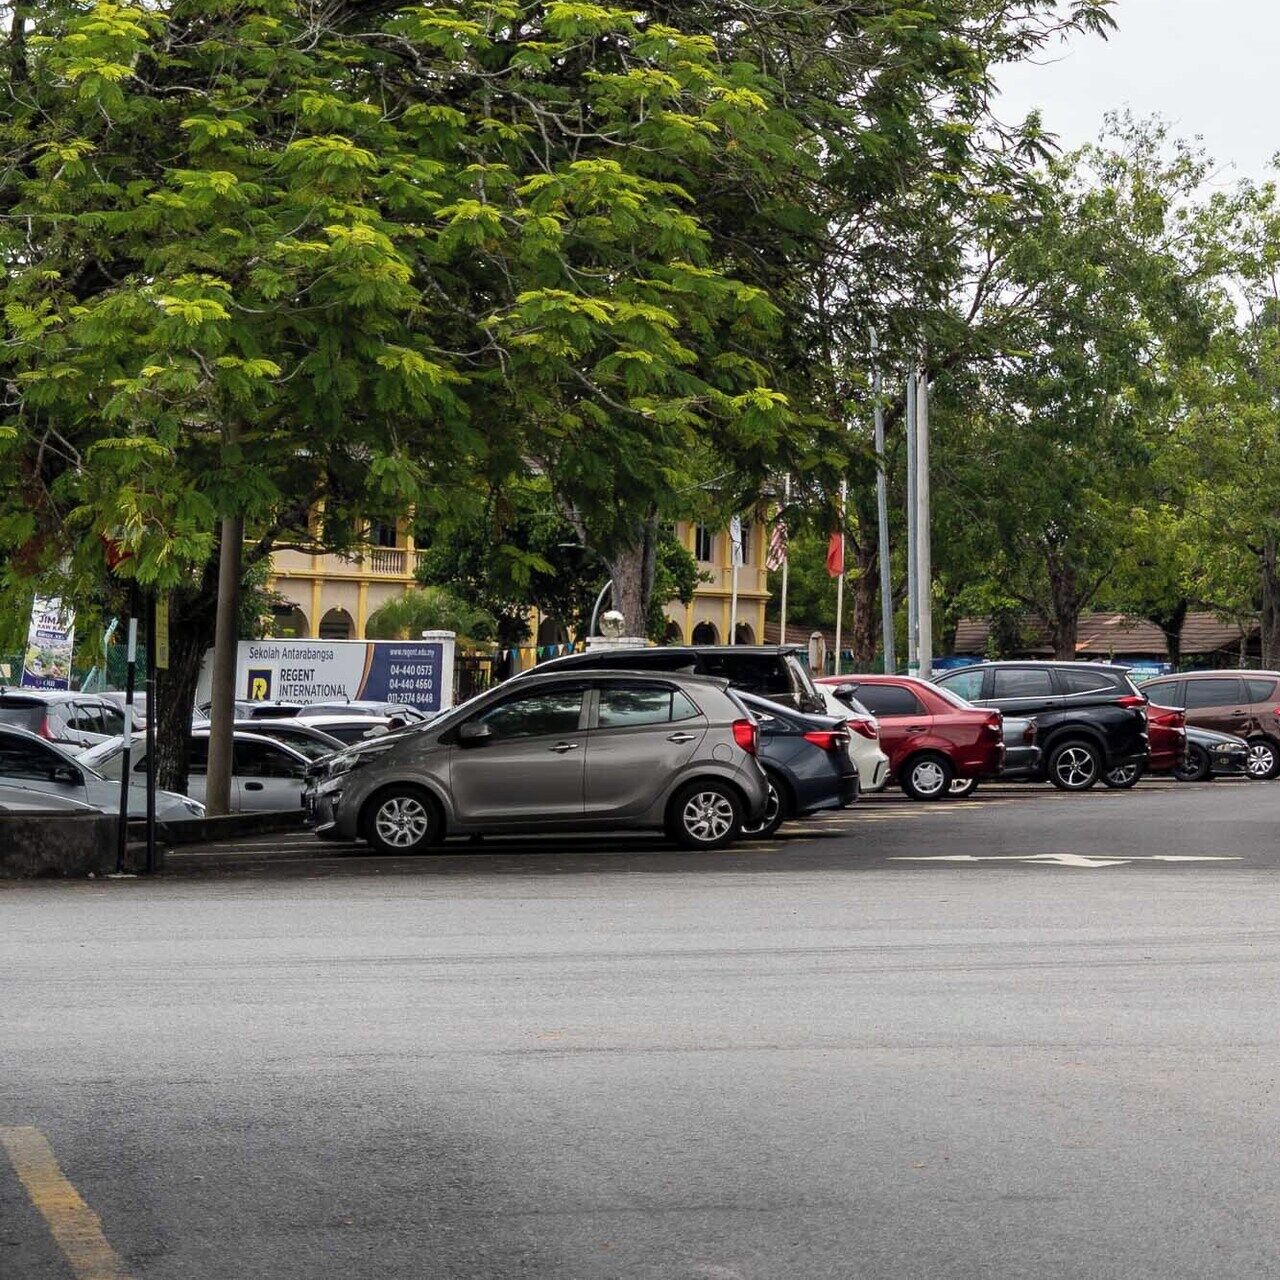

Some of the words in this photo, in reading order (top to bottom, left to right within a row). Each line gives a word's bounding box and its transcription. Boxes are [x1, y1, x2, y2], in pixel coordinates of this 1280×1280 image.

[249, 647, 280, 659] Sekolah
[282, 648, 334, 662] Antarabangsa
[280, 669, 315, 681] REGENT
[390, 665, 415, 676] 04-440
[279, 684, 348, 697] INTERNATIONAL
